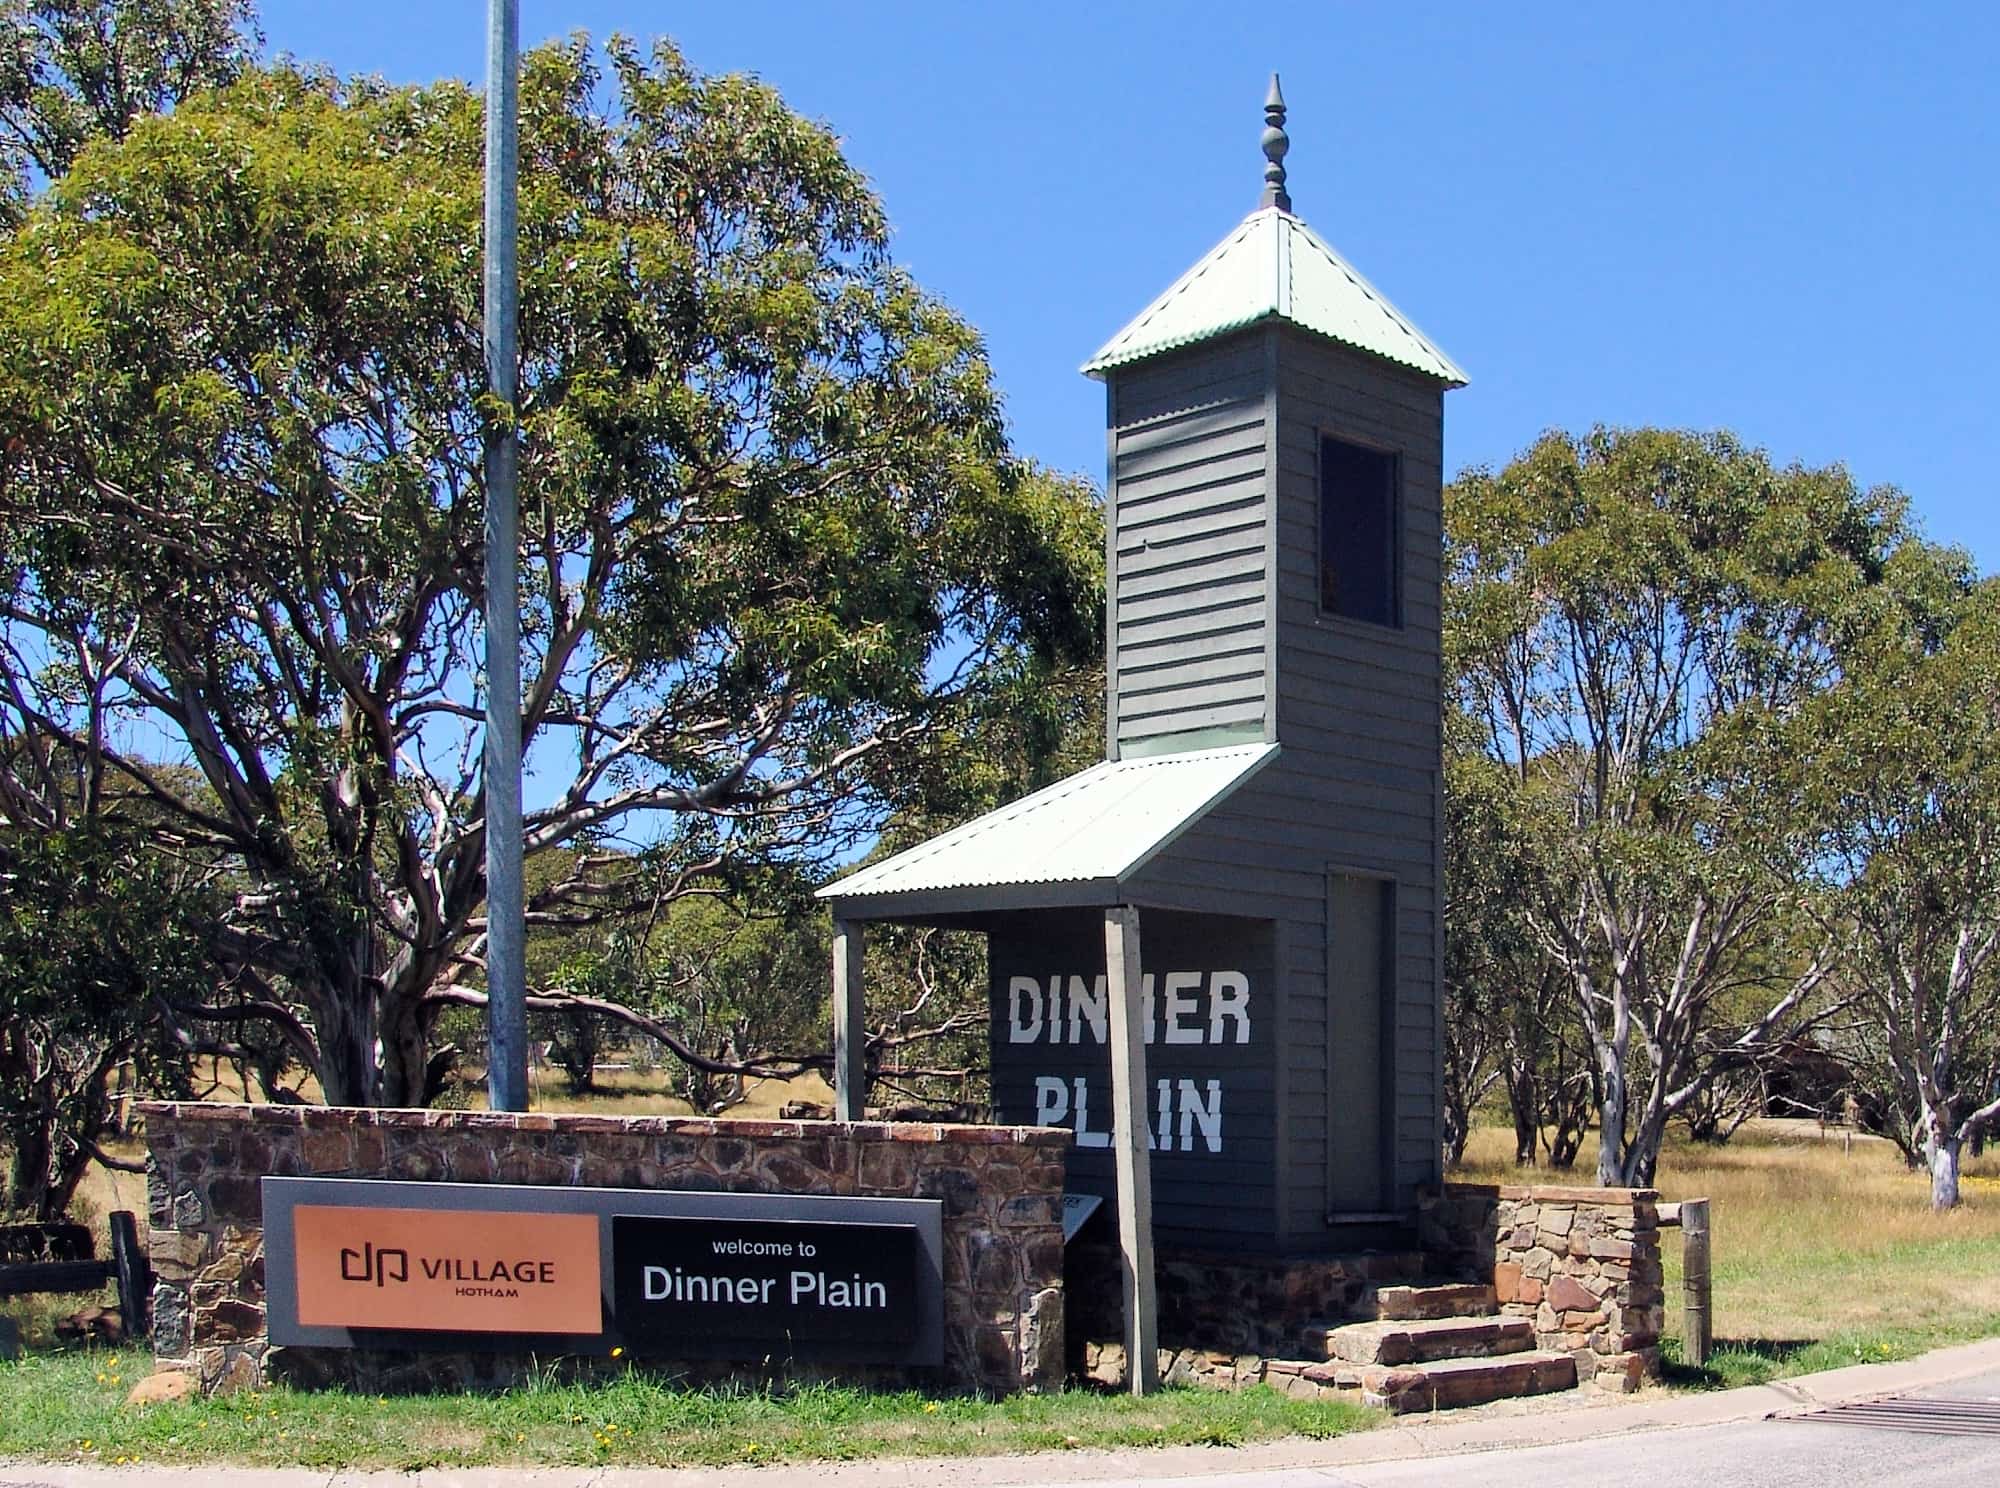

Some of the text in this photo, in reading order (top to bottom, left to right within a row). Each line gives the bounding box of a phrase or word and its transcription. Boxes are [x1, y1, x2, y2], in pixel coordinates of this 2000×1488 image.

[1035, 1077, 1222, 1152] PLIN
[712, 1239, 817, 1256] welcome to
[420, 1258, 555, 1283] VILLAGE
[455, 1287, 519, 1298] HOTHAM
[644, 1266, 887, 1308] Dinner Plain
